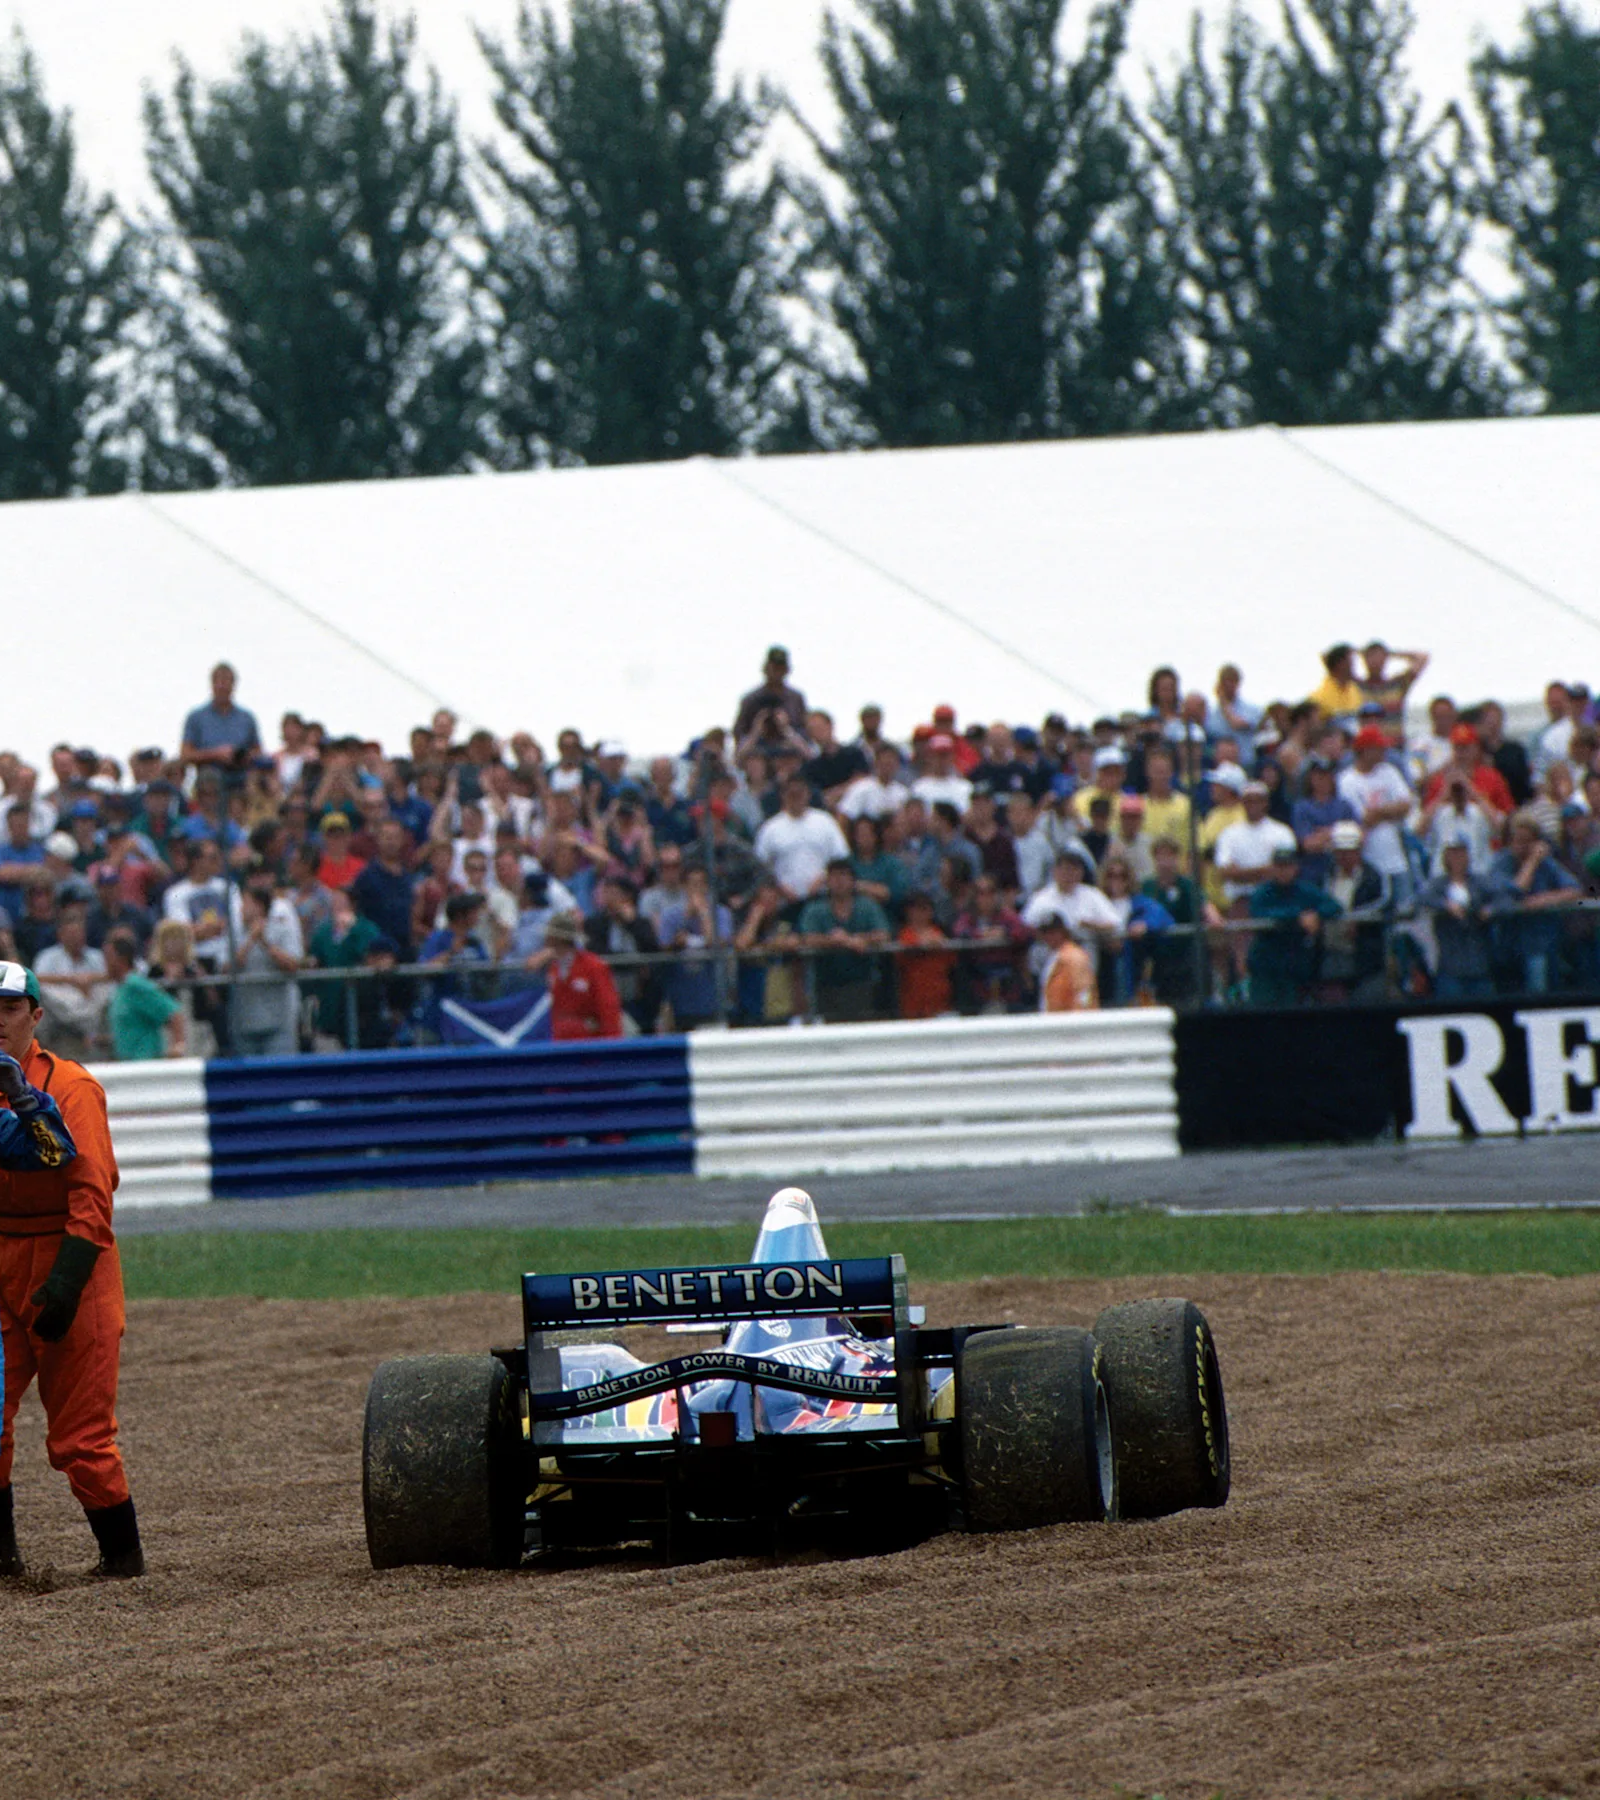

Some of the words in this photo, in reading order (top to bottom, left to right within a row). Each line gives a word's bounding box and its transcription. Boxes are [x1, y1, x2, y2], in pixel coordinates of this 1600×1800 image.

[572, 1264, 844, 1311] BENETTON
[576, 1364, 671, 1402] BENETTON
[681, 1354, 747, 1371] POWER
[757, 1361, 780, 1374] BY
[787, 1366, 882, 1394] RENAULT
